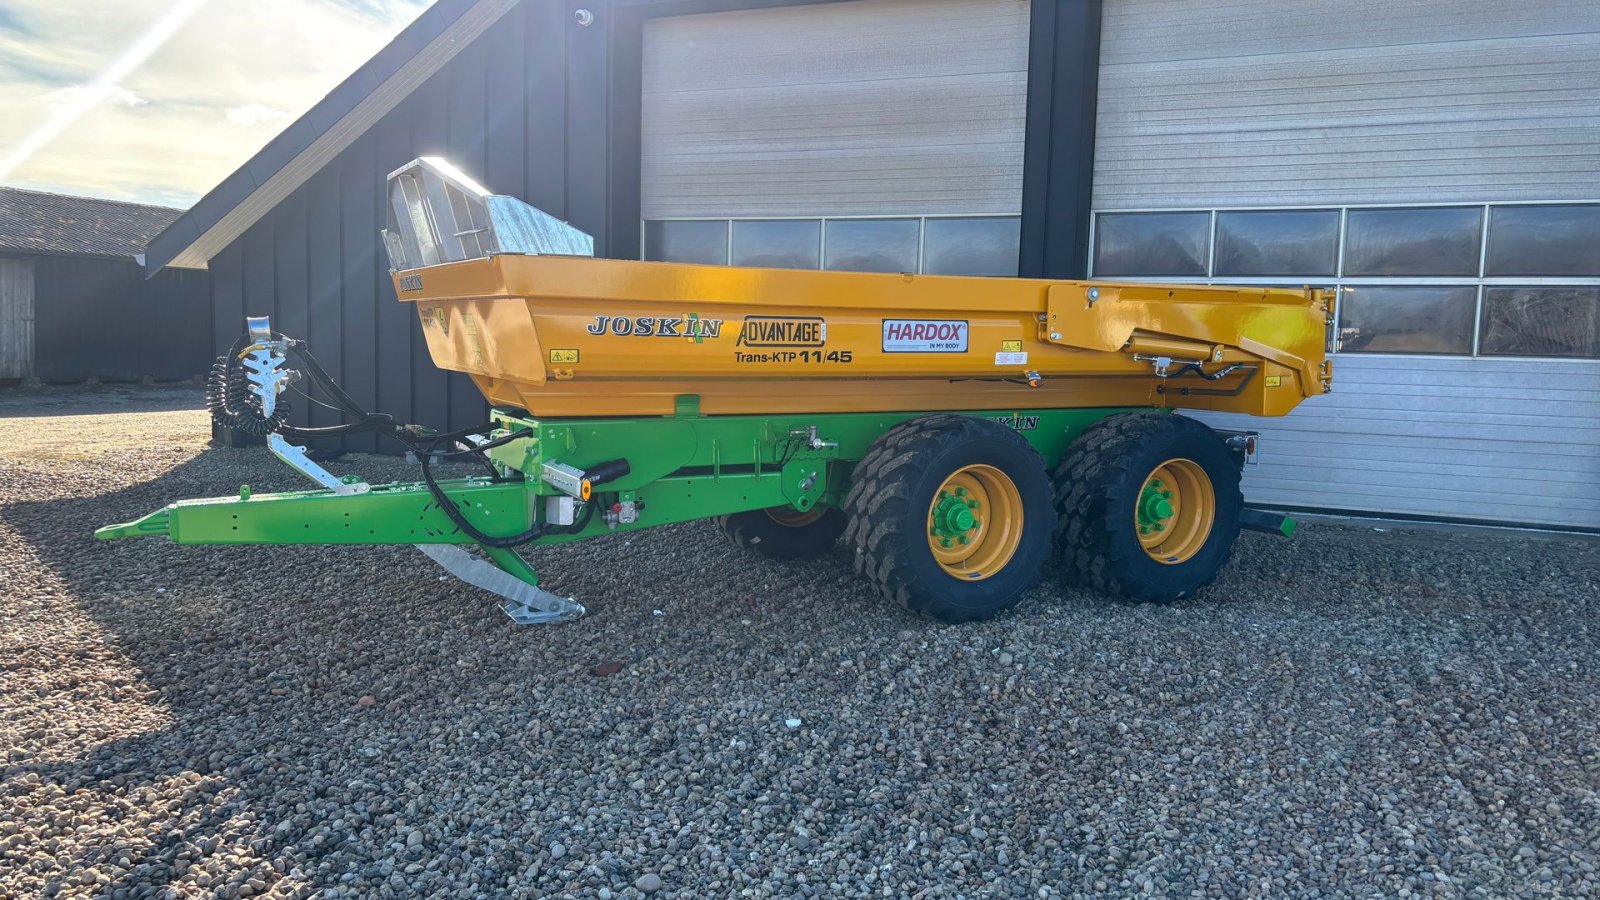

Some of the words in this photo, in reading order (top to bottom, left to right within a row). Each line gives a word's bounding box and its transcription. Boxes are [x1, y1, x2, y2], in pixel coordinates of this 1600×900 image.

[587, 315, 723, 337] JOSKIN
[736, 321, 820, 347] ADVANTAGE
[887, 323, 962, 341] HARDOX
[734, 351, 797, 363] Trans-KTP
[799, 350, 852, 364] 11/45
[986, 415, 1039, 431] KIN
